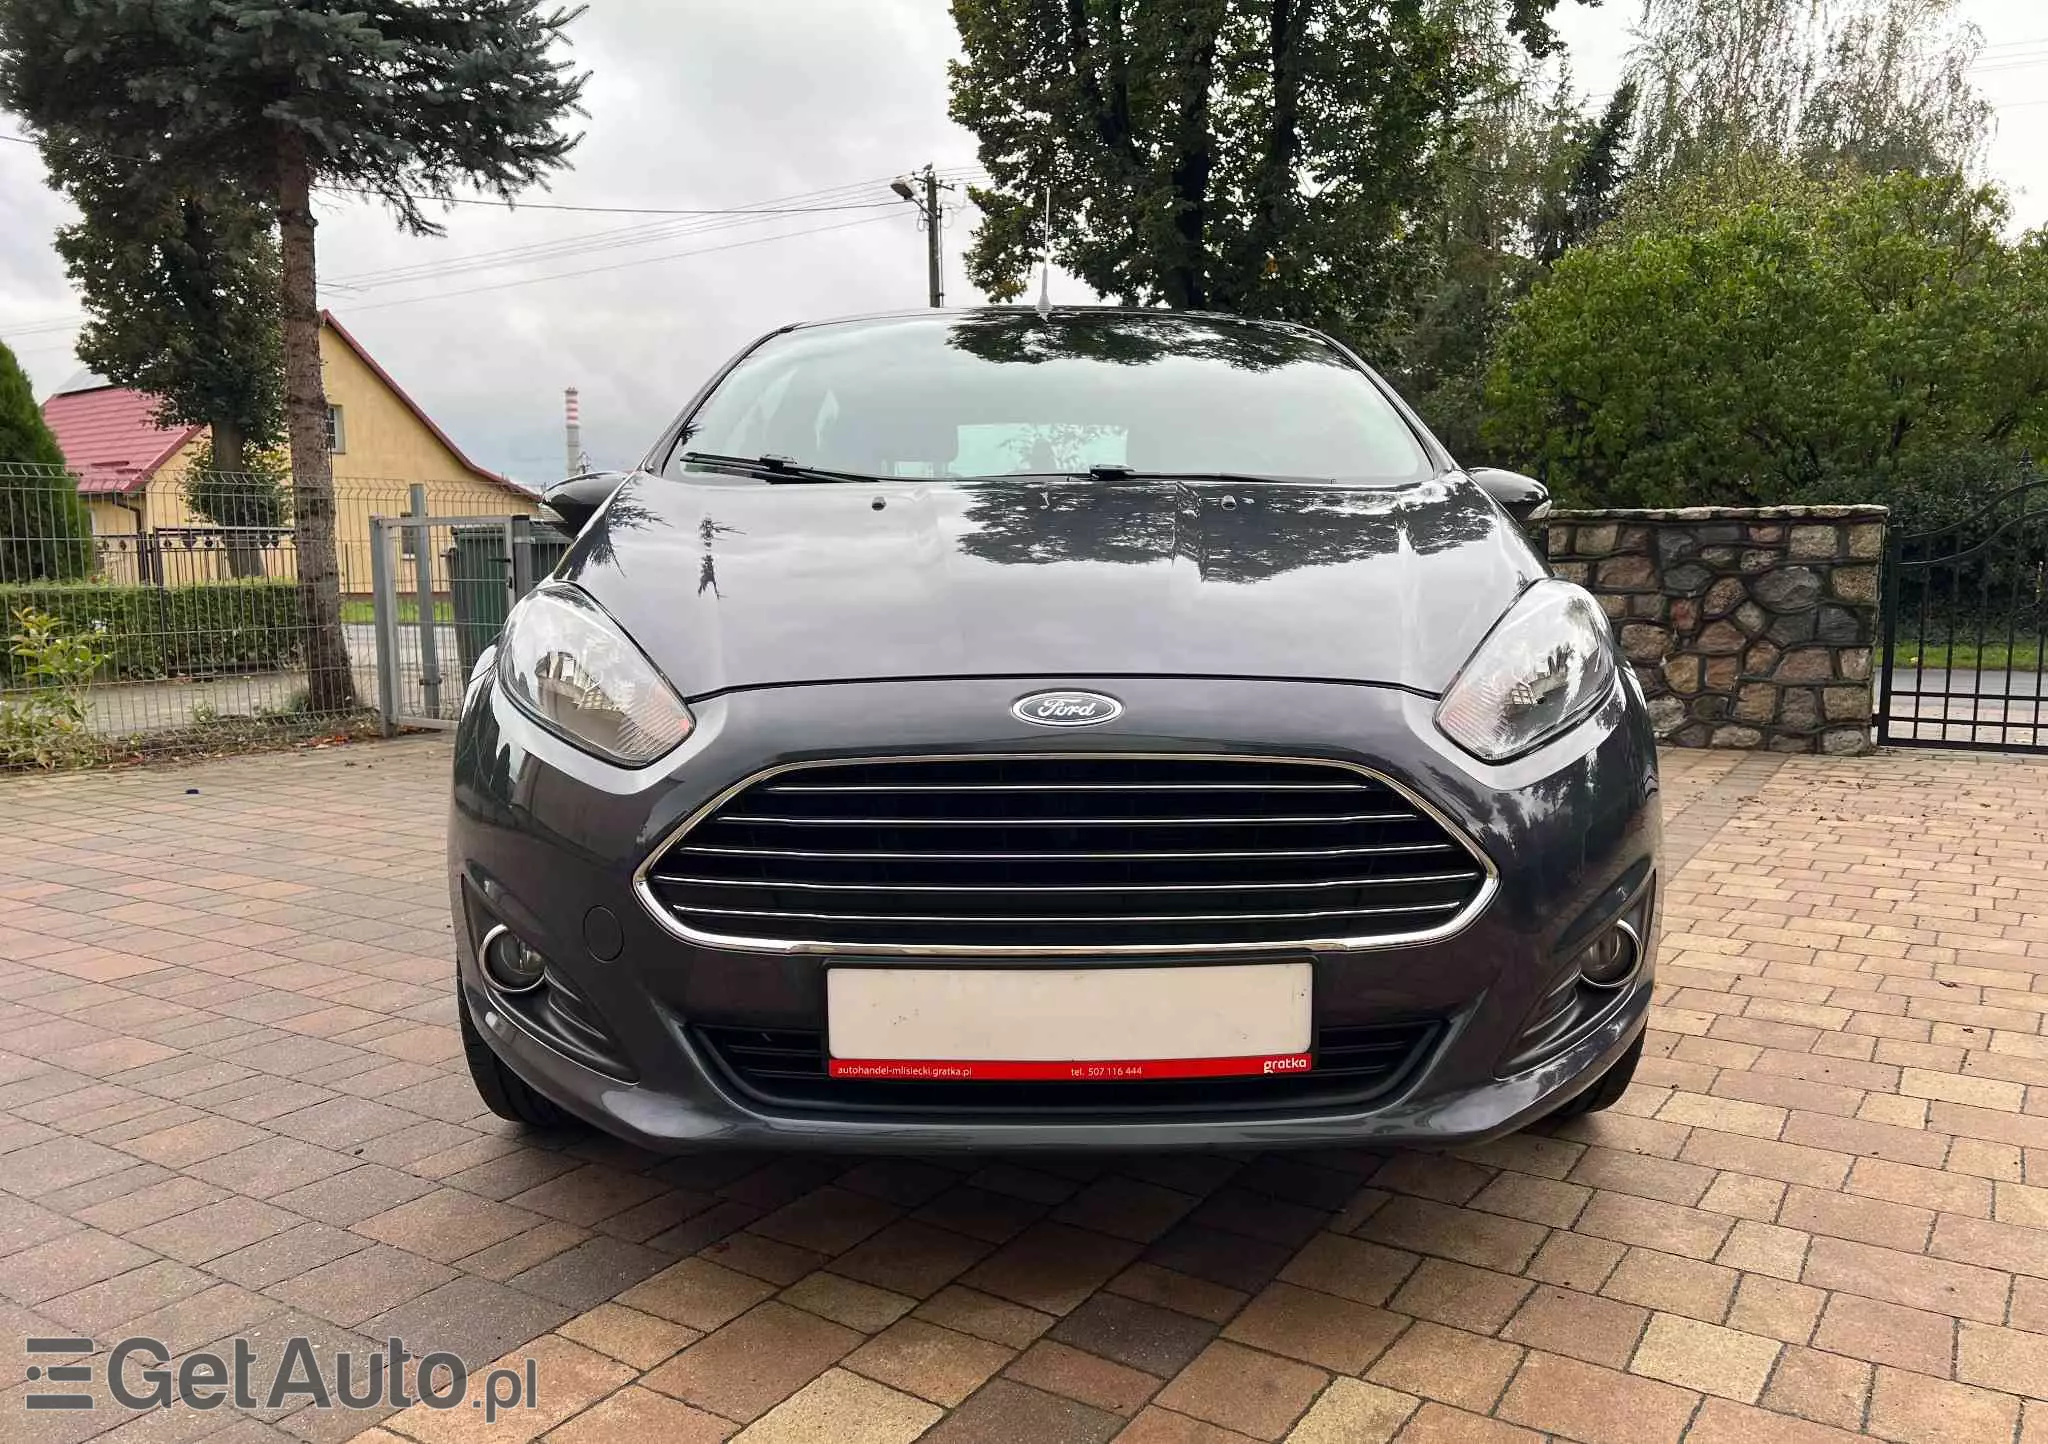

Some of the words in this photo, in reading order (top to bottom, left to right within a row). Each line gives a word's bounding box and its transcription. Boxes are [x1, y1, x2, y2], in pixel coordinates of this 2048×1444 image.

[1037, 699, 1097, 717] Ford
[837, 1065, 972, 1078] autohandel-mlisiecki.gratka.pl
[1071, 1067, 1085, 1077] tel.
[1088, 1067, 1105, 1077] 507
[1107, 1066, 1124, 1077] 116
[1125, 1066, 1143, 1077] 444
[1263, 1058, 1307, 1074] gratka
